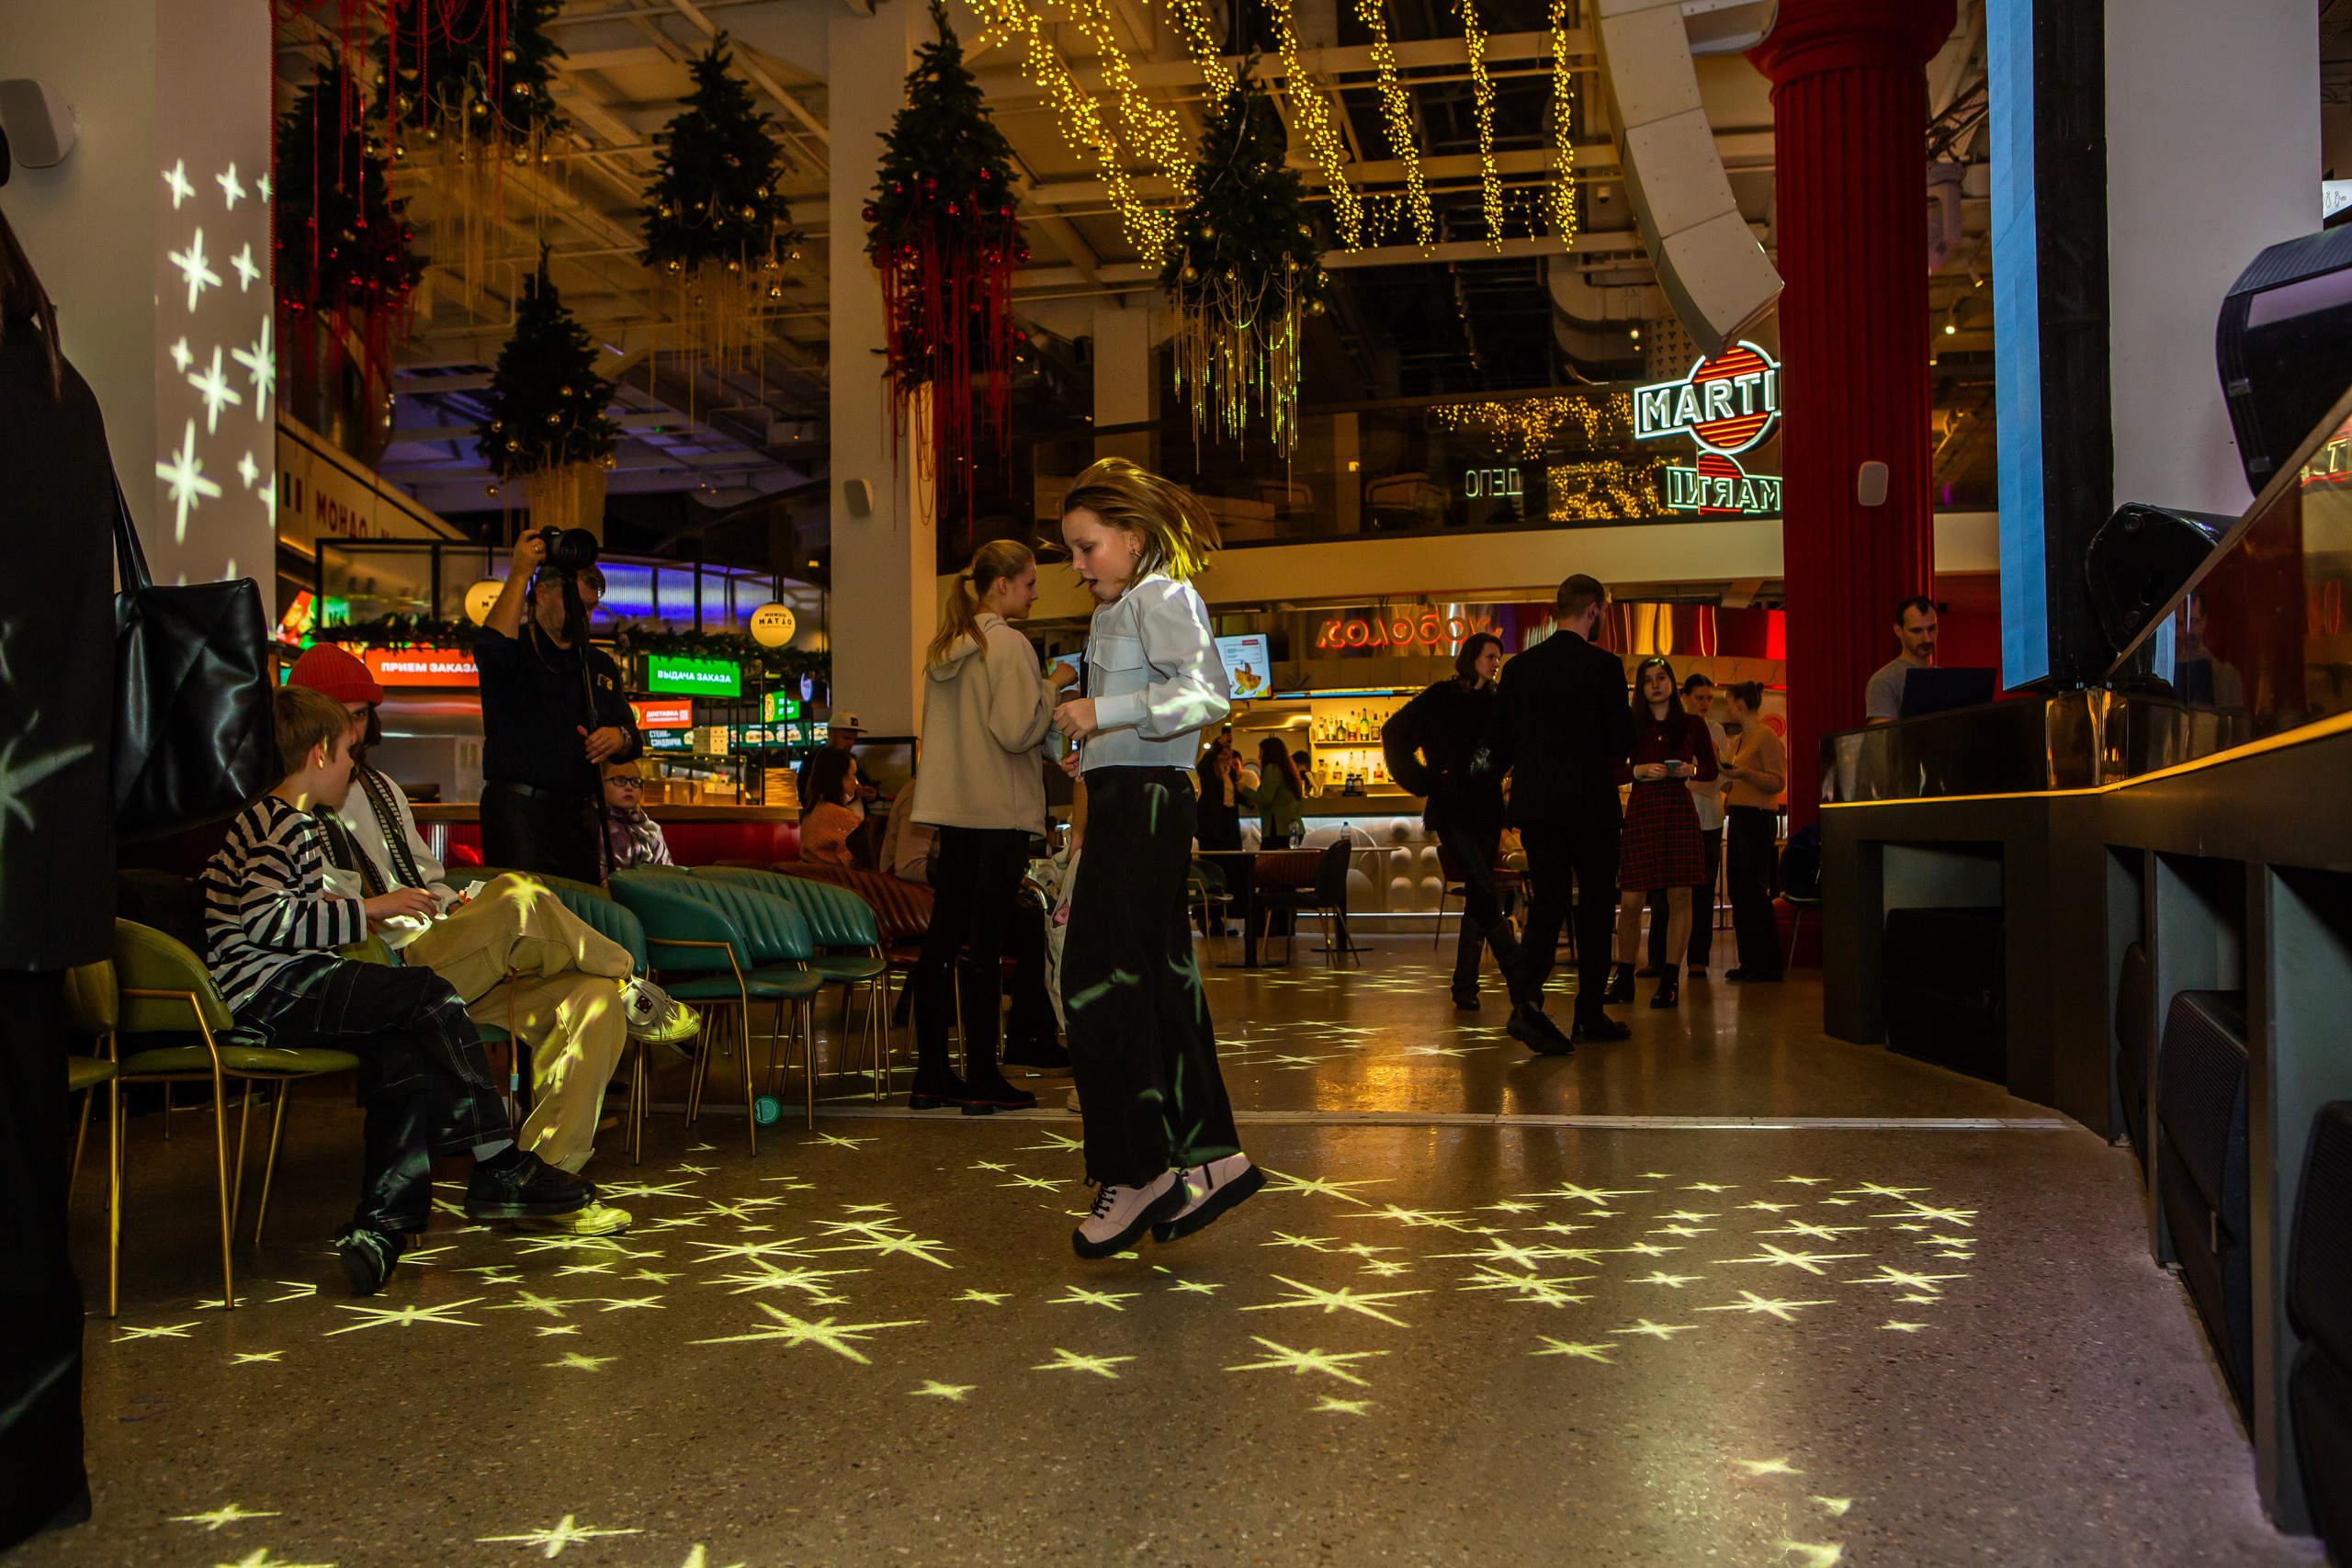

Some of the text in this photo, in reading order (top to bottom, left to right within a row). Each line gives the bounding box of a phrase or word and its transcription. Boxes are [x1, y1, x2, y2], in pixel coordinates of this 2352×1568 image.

[381, 661, 479, 673] ПРИЕМ ЗАКАЗА
[658, 670, 731, 682] ВЫДАЧА ЗАКАЗА
